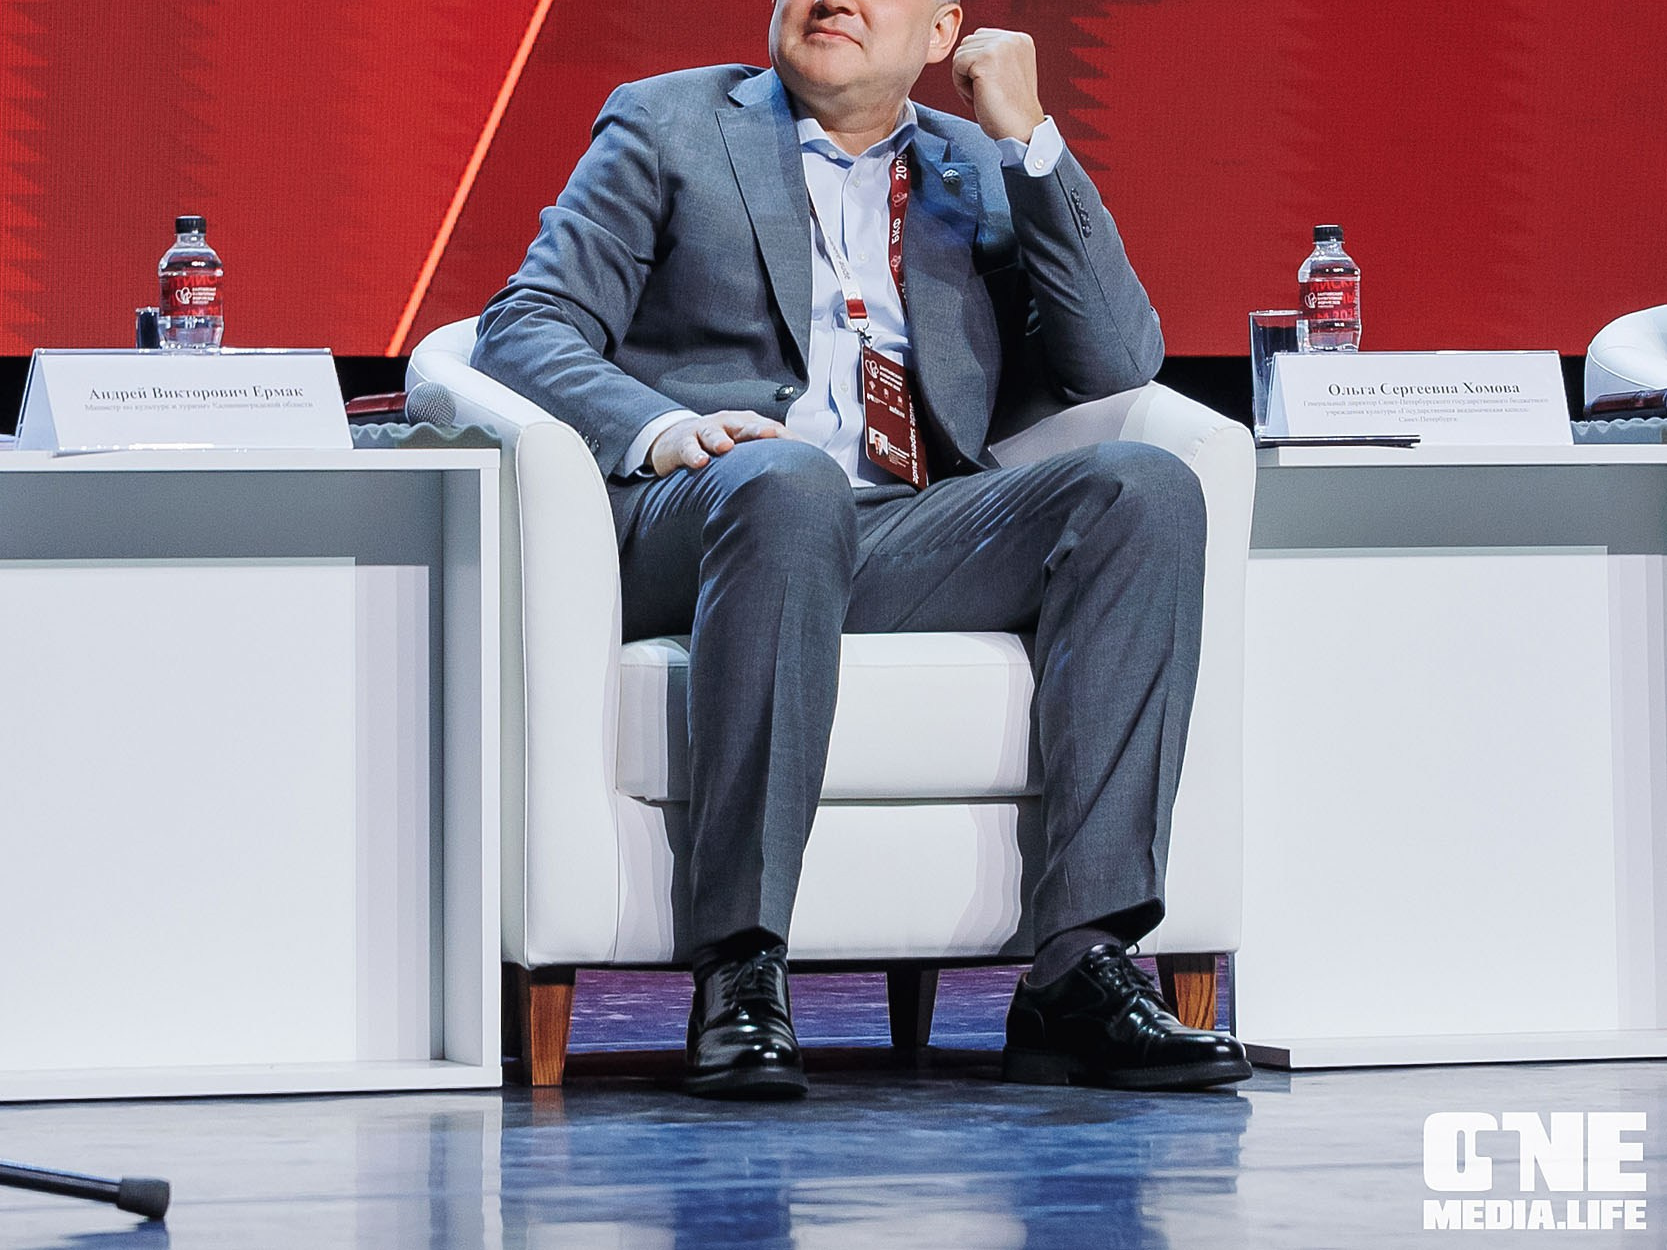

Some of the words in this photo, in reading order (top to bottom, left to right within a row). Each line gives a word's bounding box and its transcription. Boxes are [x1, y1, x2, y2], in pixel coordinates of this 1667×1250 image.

[895, 153, 908, 180] 2026
[892, 217, 902, 244] БКФ
[90, 387, 147, 402] Андрей
[152, 387, 247, 401] Викторович
[252, 385, 304, 400] Ермак
[1328, 383, 1376, 396] Ольга
[1380, 382, 1459, 397] Сергеевна
[1462, 382, 1521, 394] Хомова
[911, 459, 919, 484] aude
